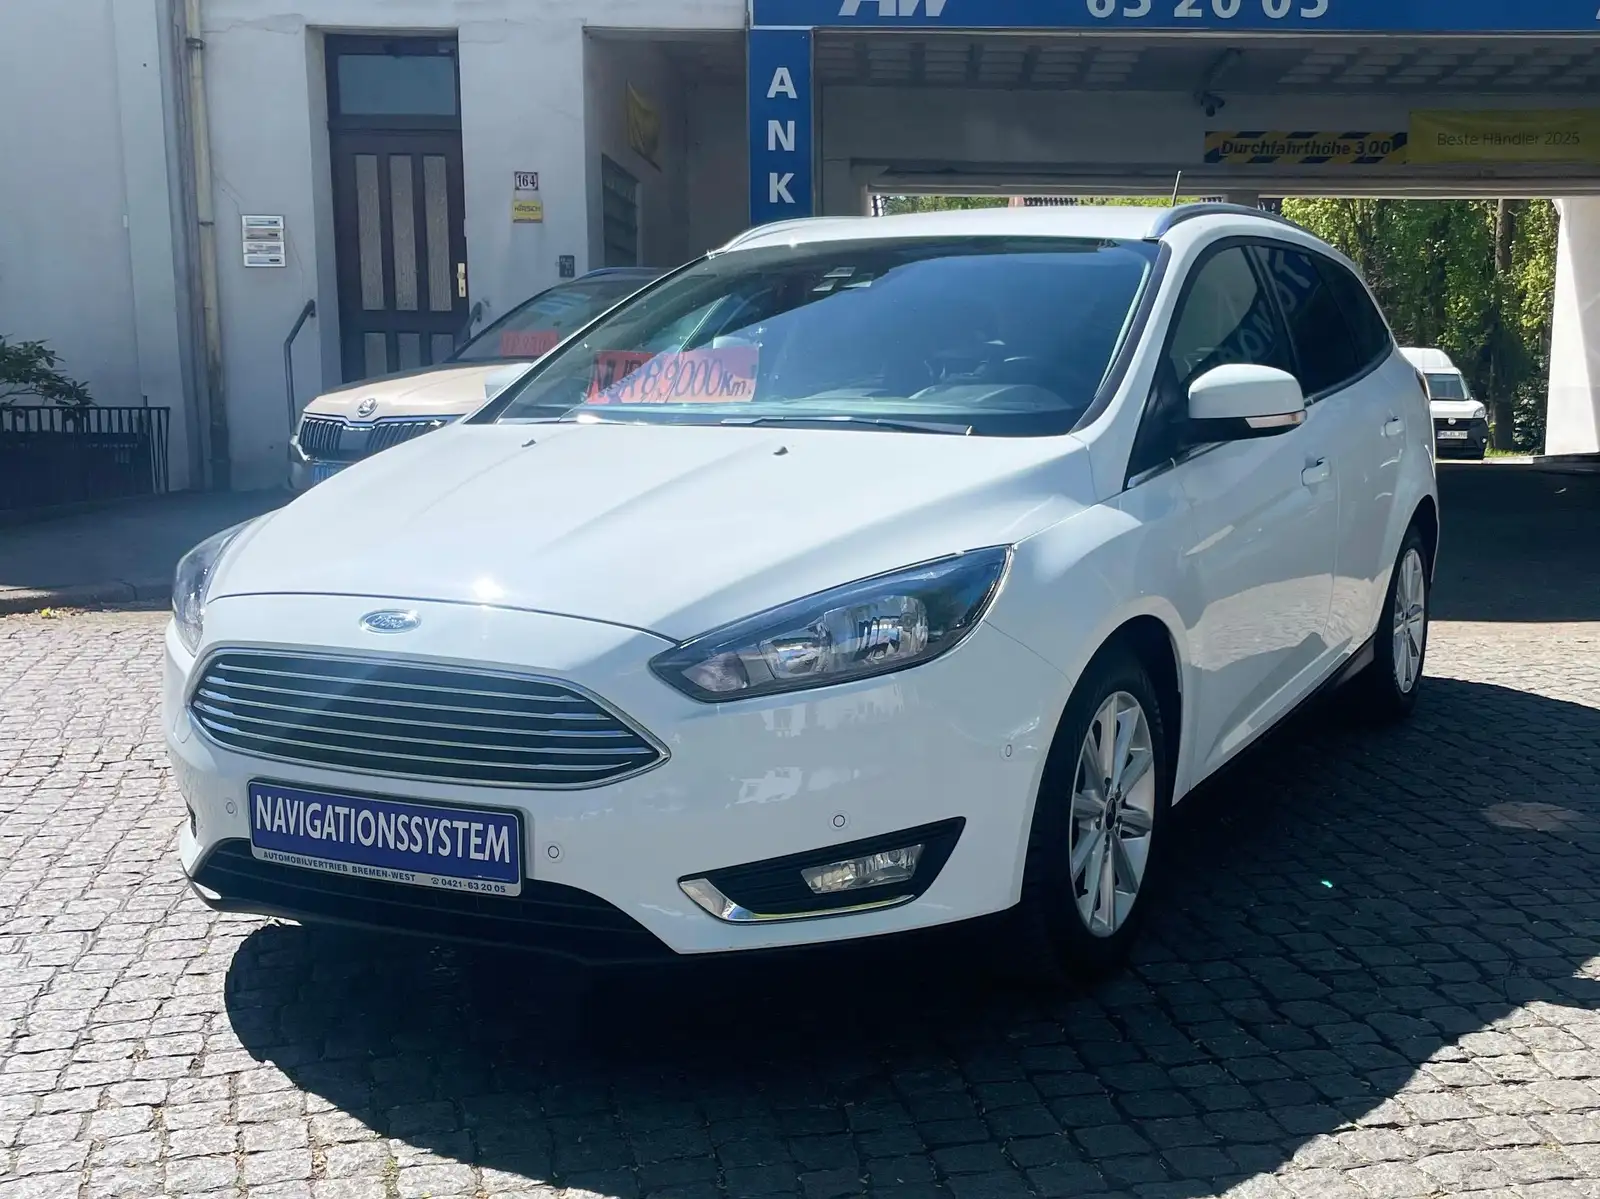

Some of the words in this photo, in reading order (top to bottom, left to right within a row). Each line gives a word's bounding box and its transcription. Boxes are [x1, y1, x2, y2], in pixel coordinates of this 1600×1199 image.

[1436, 132, 1479, 147] Beste
[1482, 131, 1540, 147] Händler
[1543, 131, 1581, 146] 2025
[1219, 140, 1351, 155] Durchfahrthöhe
[516, 174, 536, 188] 164
[255, 794, 511, 863] NAVIGATIONSSYSTEM
[263, 851, 348, 872] AUTOMOBILVERTRIEB
[351, 866, 416, 882] BREMEN-WEST
